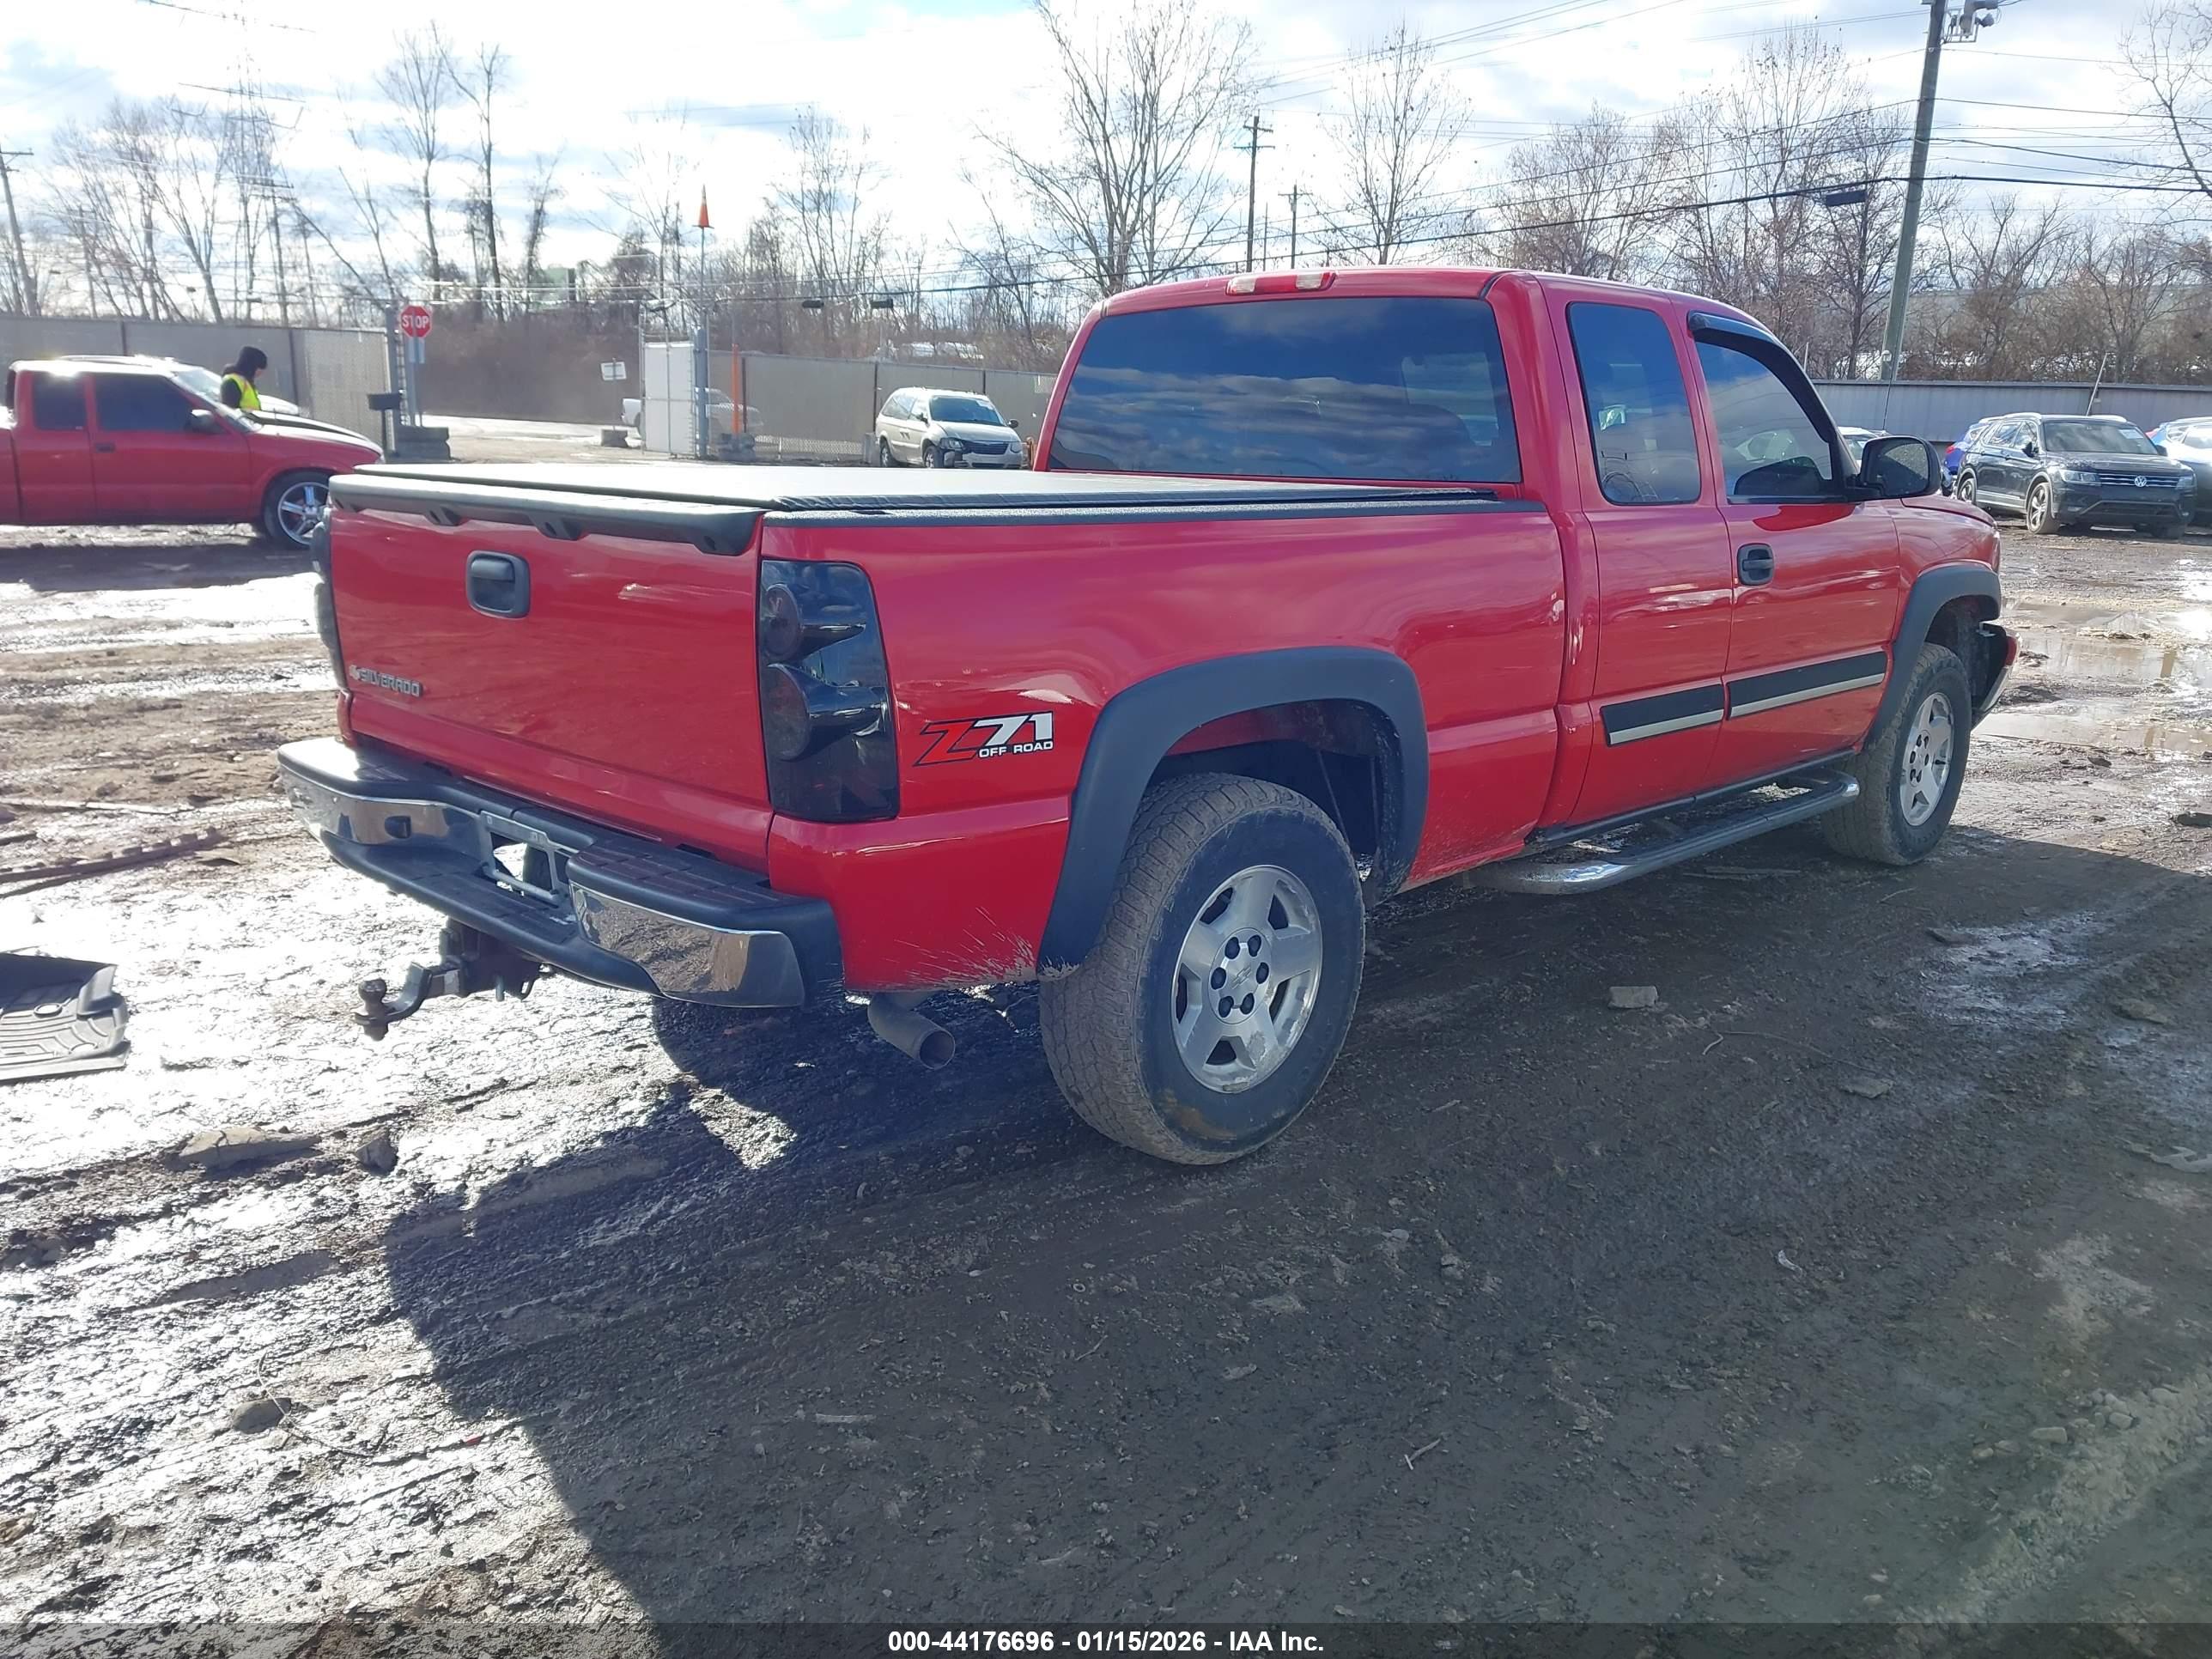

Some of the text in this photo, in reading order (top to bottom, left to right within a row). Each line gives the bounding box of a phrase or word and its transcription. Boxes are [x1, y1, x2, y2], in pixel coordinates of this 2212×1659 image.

[402, 314, 429, 329] STOP
[357, 667, 421, 697] SILVERADO
[913, 710, 1054, 766] Z71
[978, 740, 1054, 758] OFF ROAD
